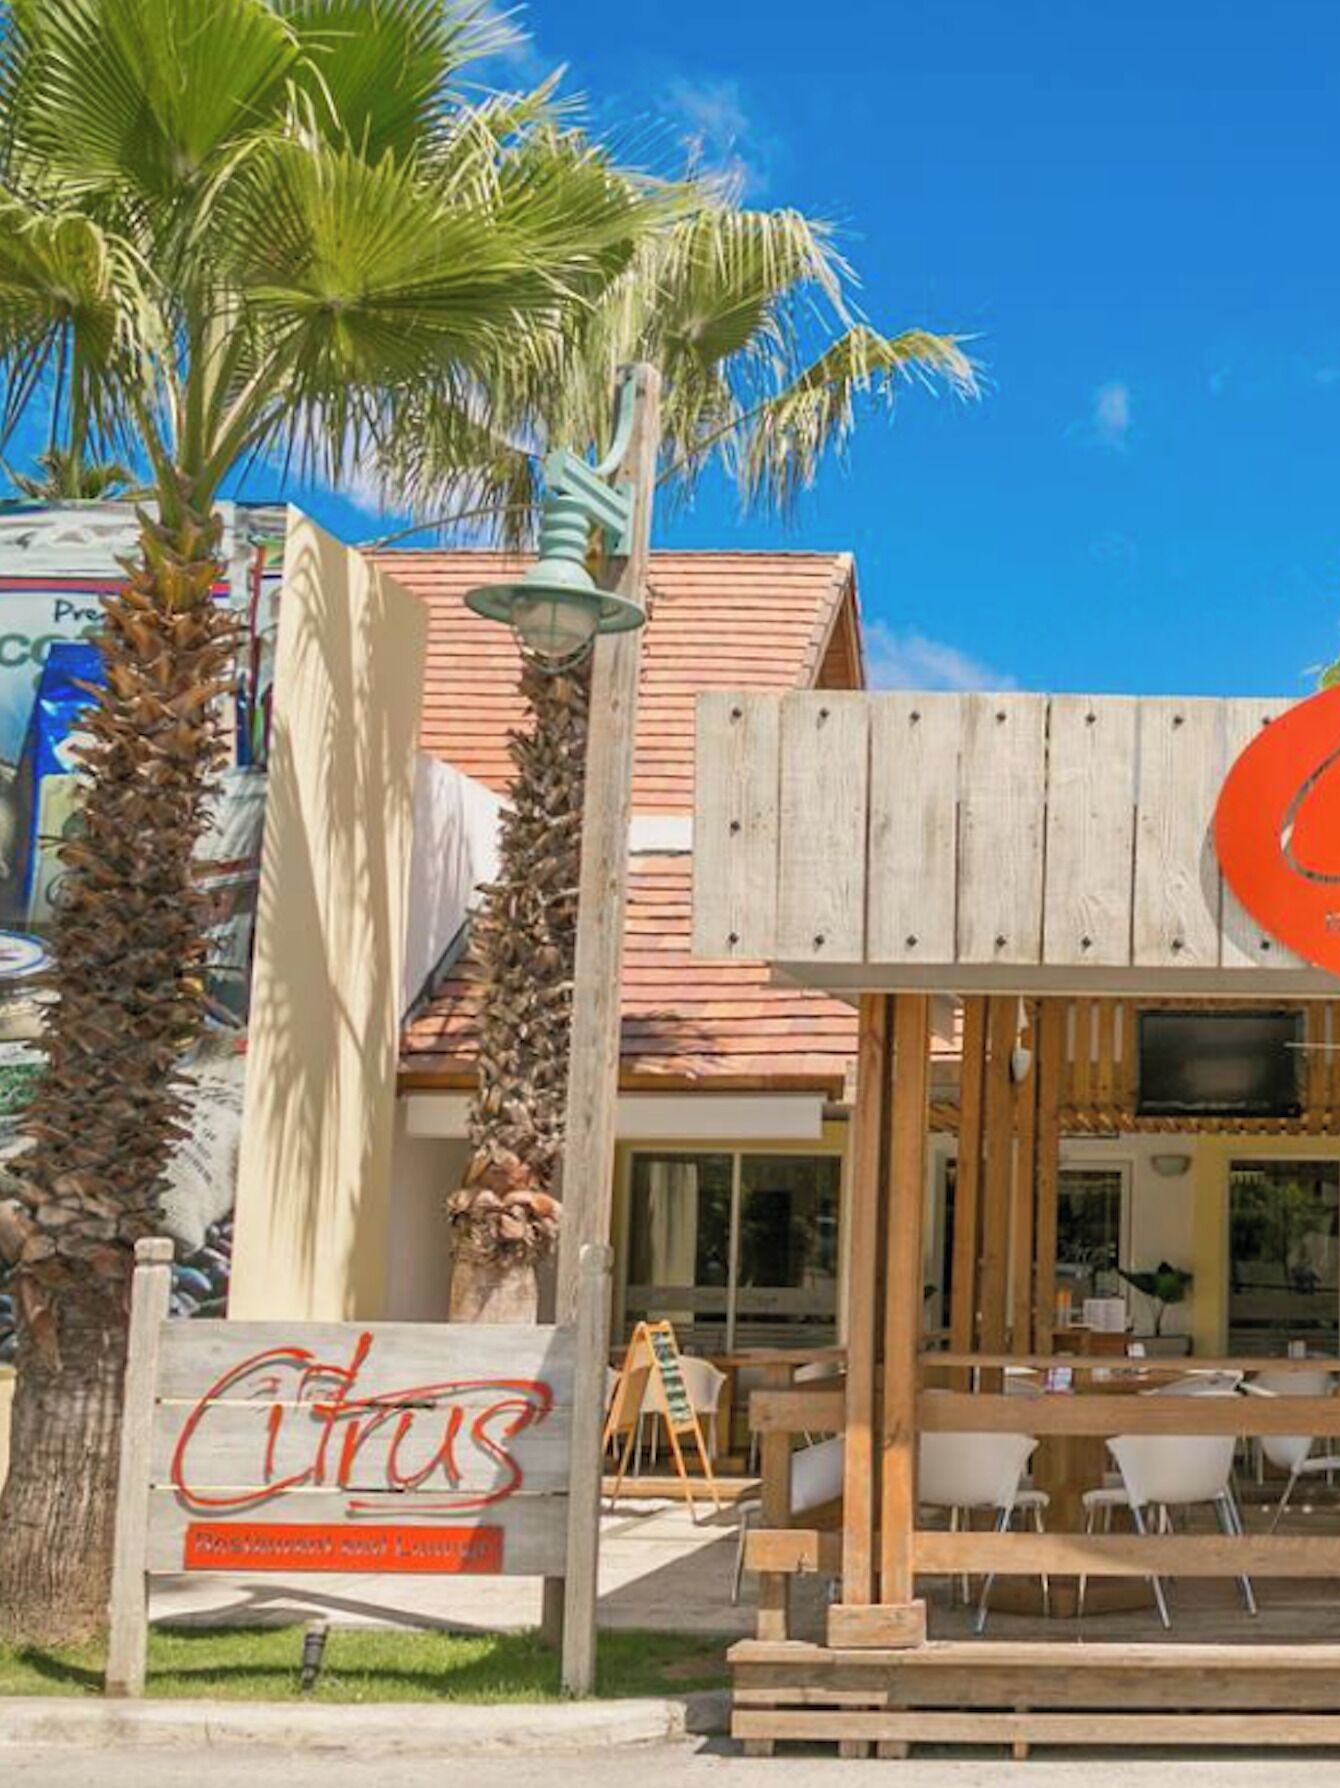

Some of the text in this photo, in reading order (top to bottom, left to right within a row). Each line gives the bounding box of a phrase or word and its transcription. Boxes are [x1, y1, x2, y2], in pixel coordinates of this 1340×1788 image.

[54, 599, 107, 622] Pre
[170, 1330, 555, 1511] Citrus
[195, 1532, 333, 1558] Restaurant
[339, 1535, 388, 1558] and
